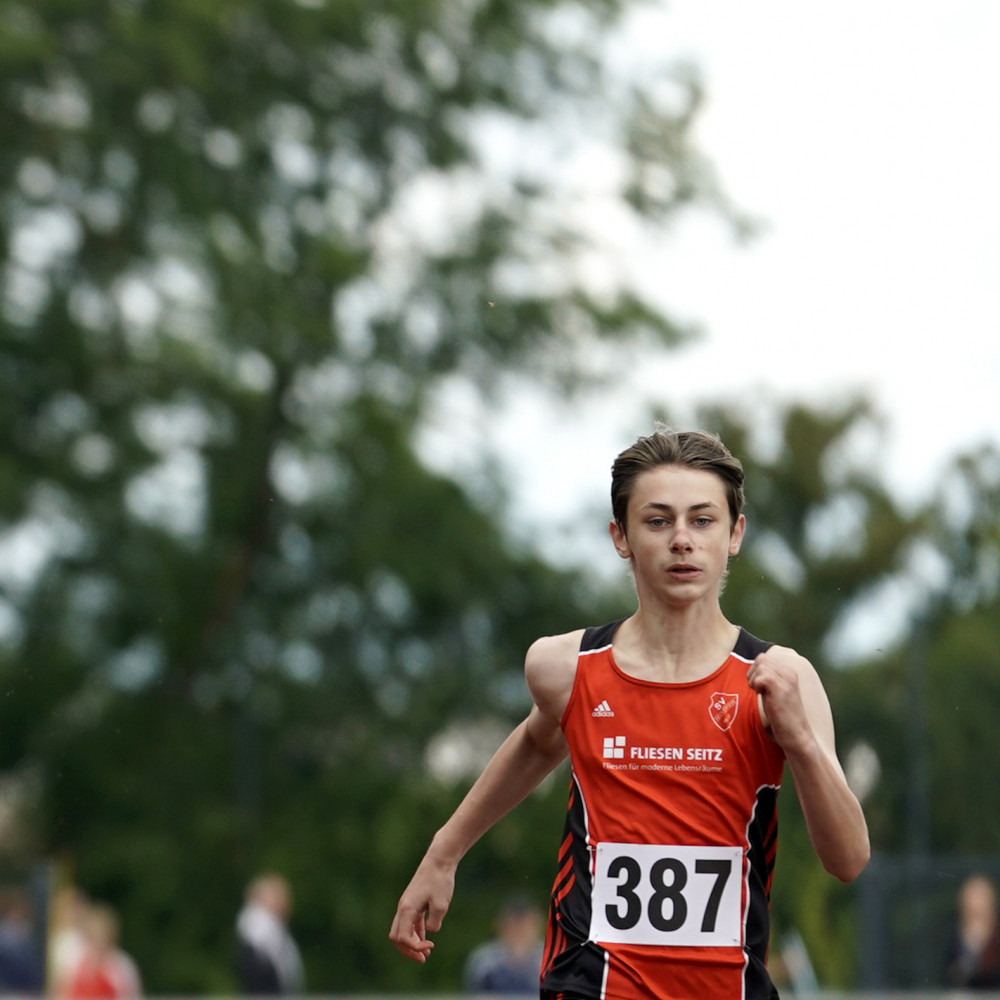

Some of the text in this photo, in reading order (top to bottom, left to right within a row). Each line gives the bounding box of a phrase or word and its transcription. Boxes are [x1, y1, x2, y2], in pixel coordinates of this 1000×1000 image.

[630, 746, 723, 761] FLIESEN SEITZ
[604, 856, 733, 933] 387
